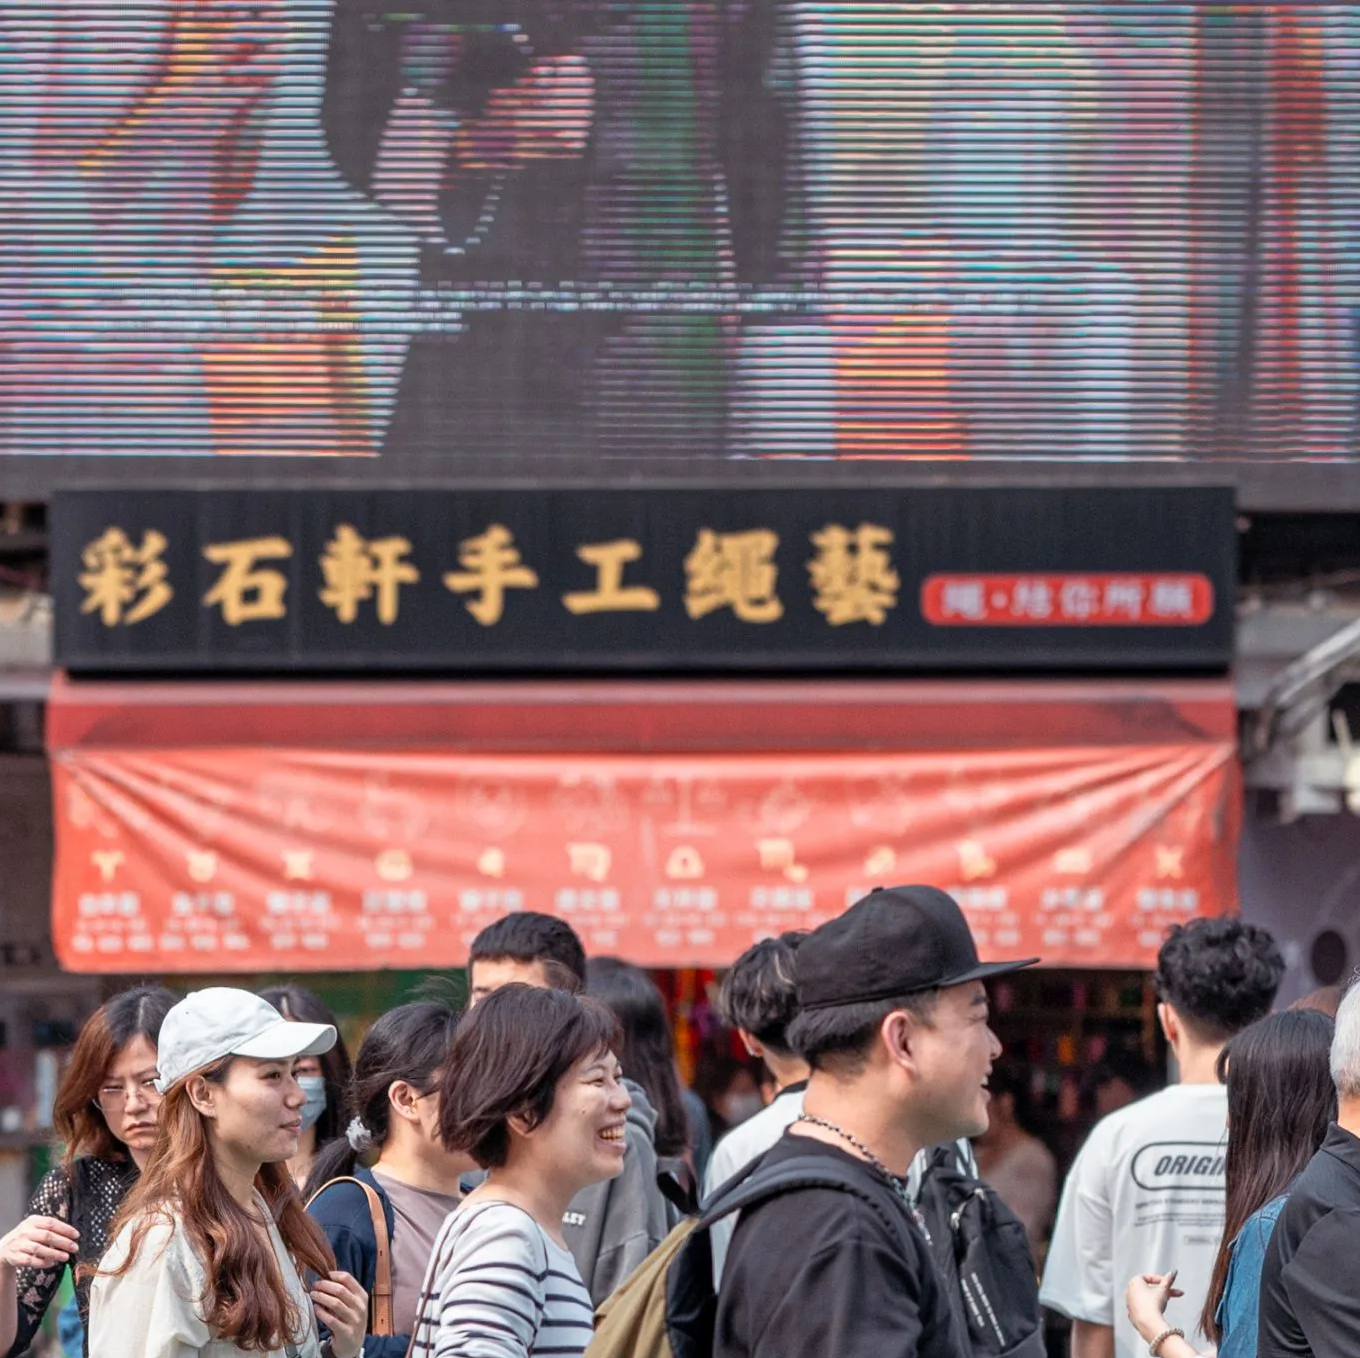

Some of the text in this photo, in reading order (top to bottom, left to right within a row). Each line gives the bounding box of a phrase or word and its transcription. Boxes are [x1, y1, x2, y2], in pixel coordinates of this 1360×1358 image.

[78, 523, 901, 627] 彩石軒手工繩藝
